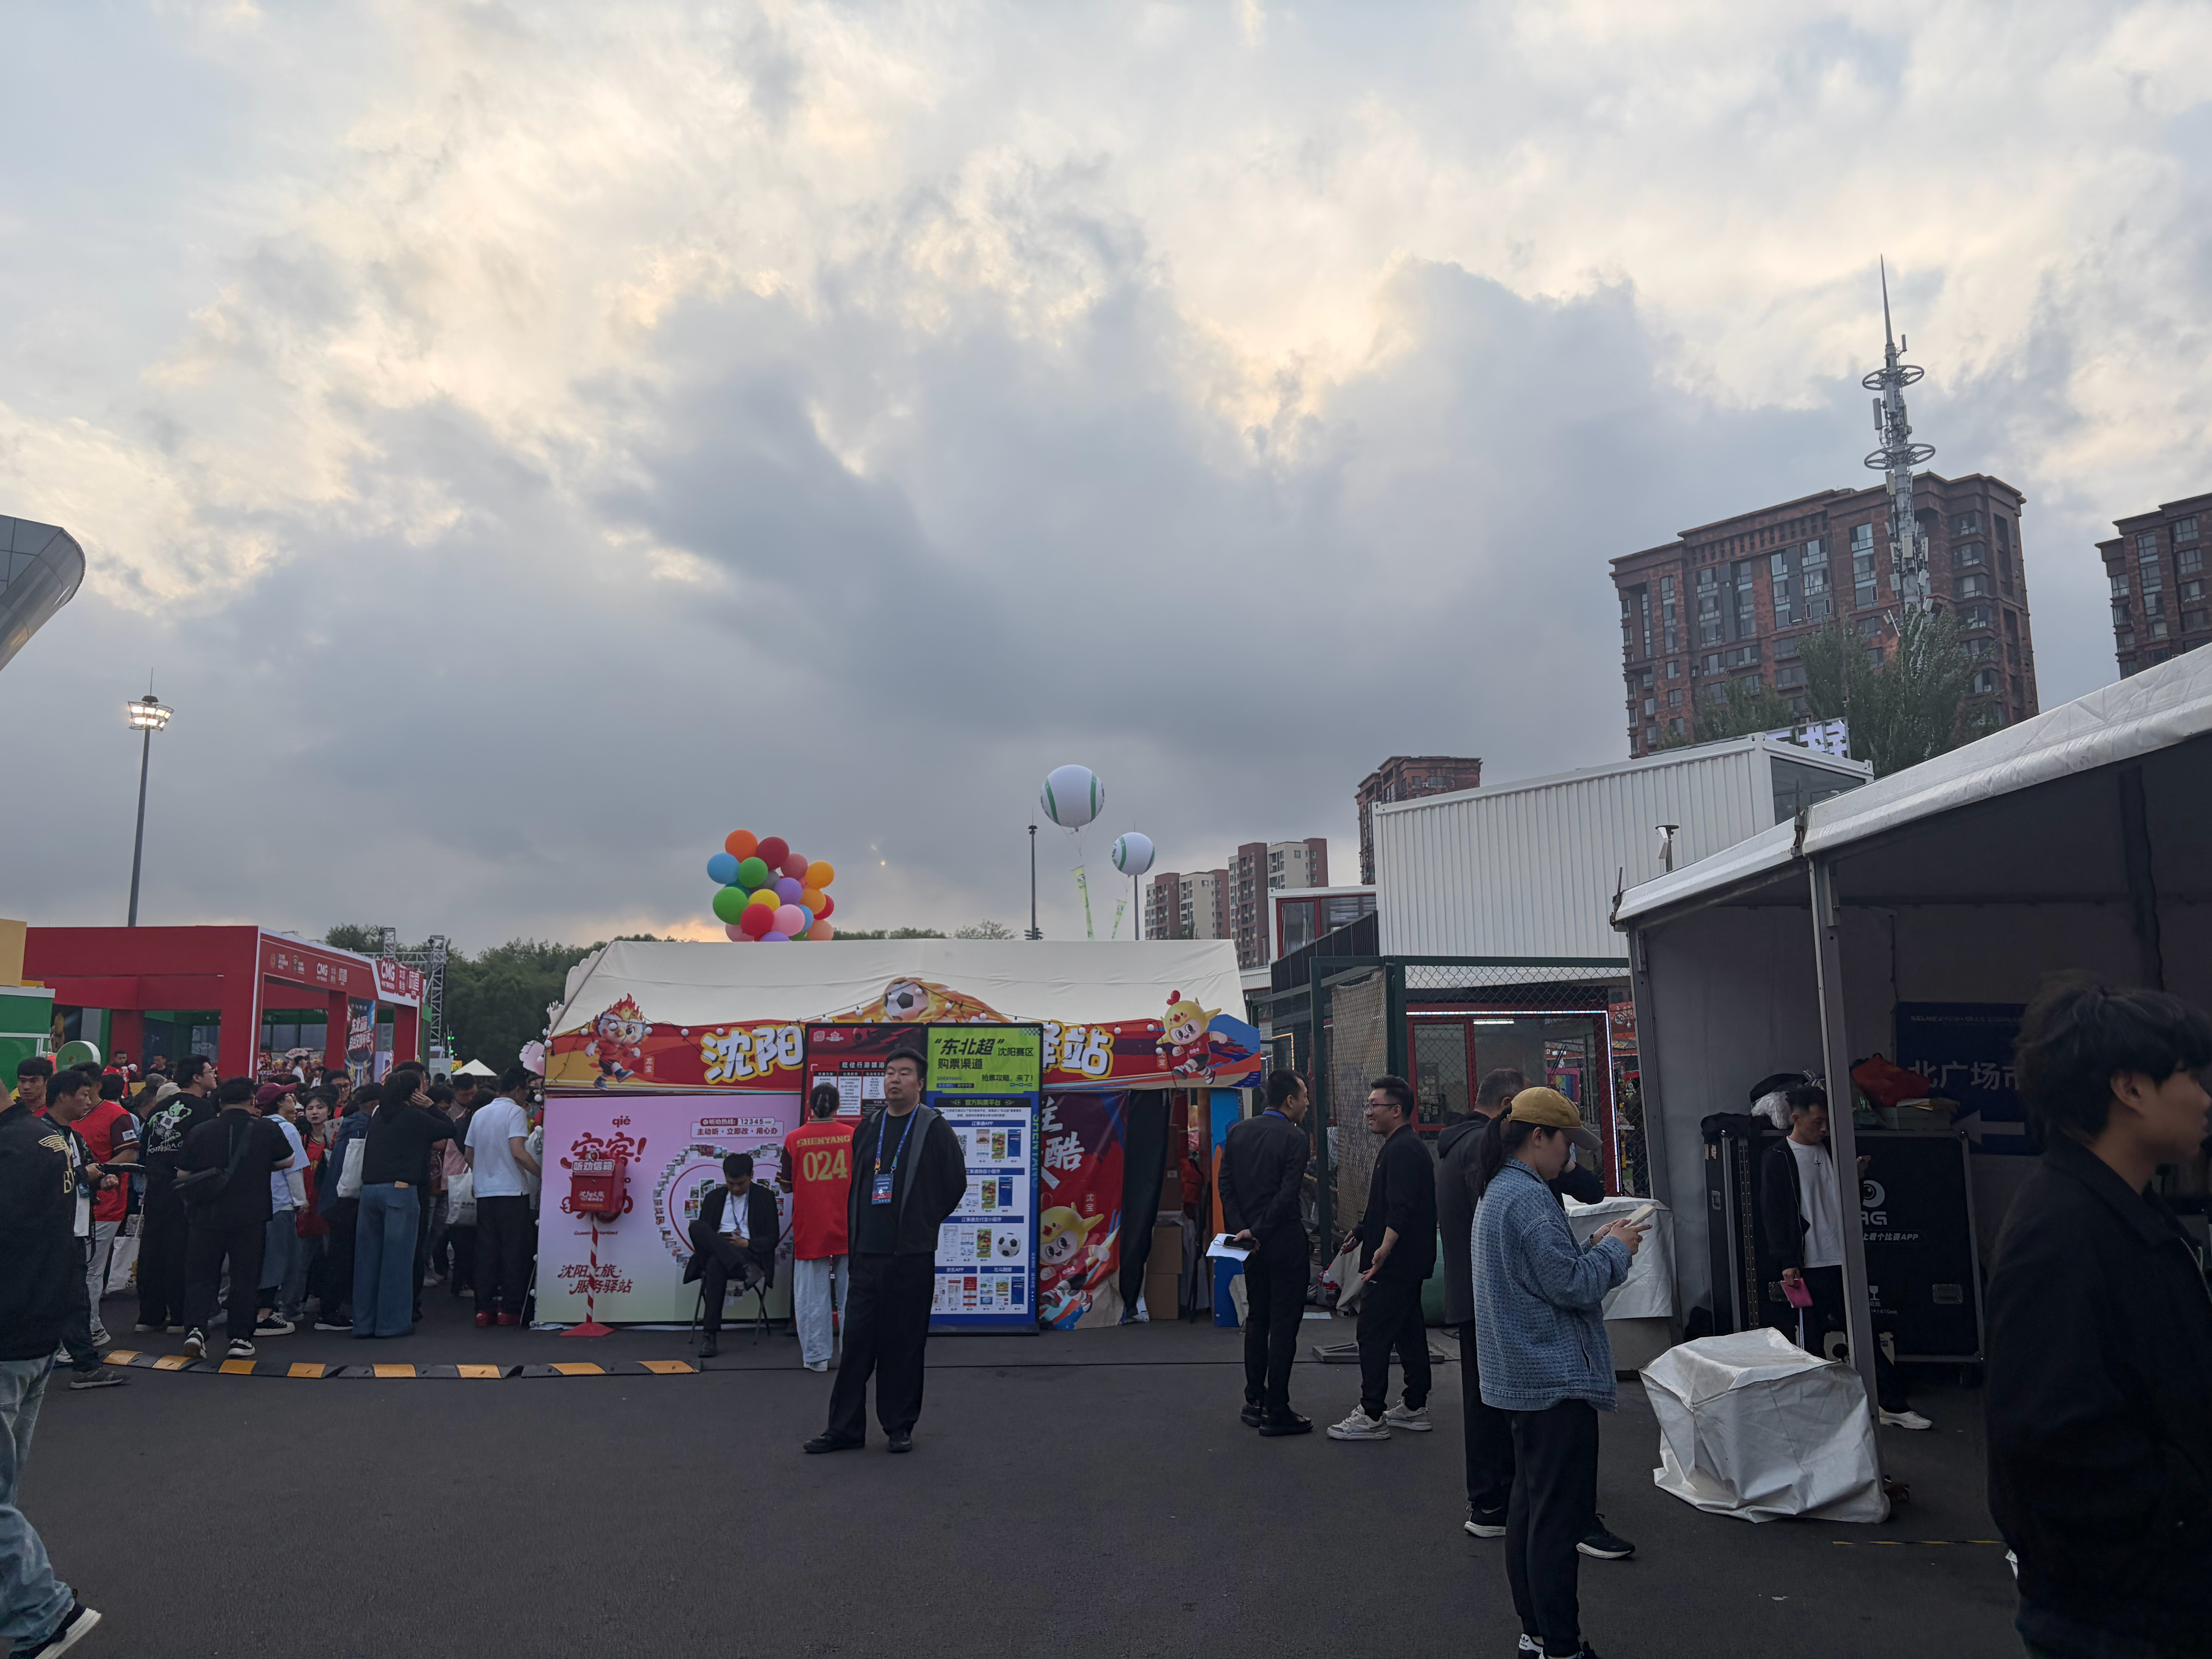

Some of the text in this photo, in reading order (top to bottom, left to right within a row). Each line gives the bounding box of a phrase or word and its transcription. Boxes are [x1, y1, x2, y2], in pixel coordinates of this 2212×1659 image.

[317, 963, 328, 976] CMG
[381, 961, 395, 981] CMG
[702, 1026, 803, 1080] 沈阳
[998, 1048, 1034, 1056] 沈阳赛区
[938, 1058, 983, 1069] 购票渠道
[796, 1135, 850, 1147] SHENYANG
[803, 1149, 848, 1182] 024
